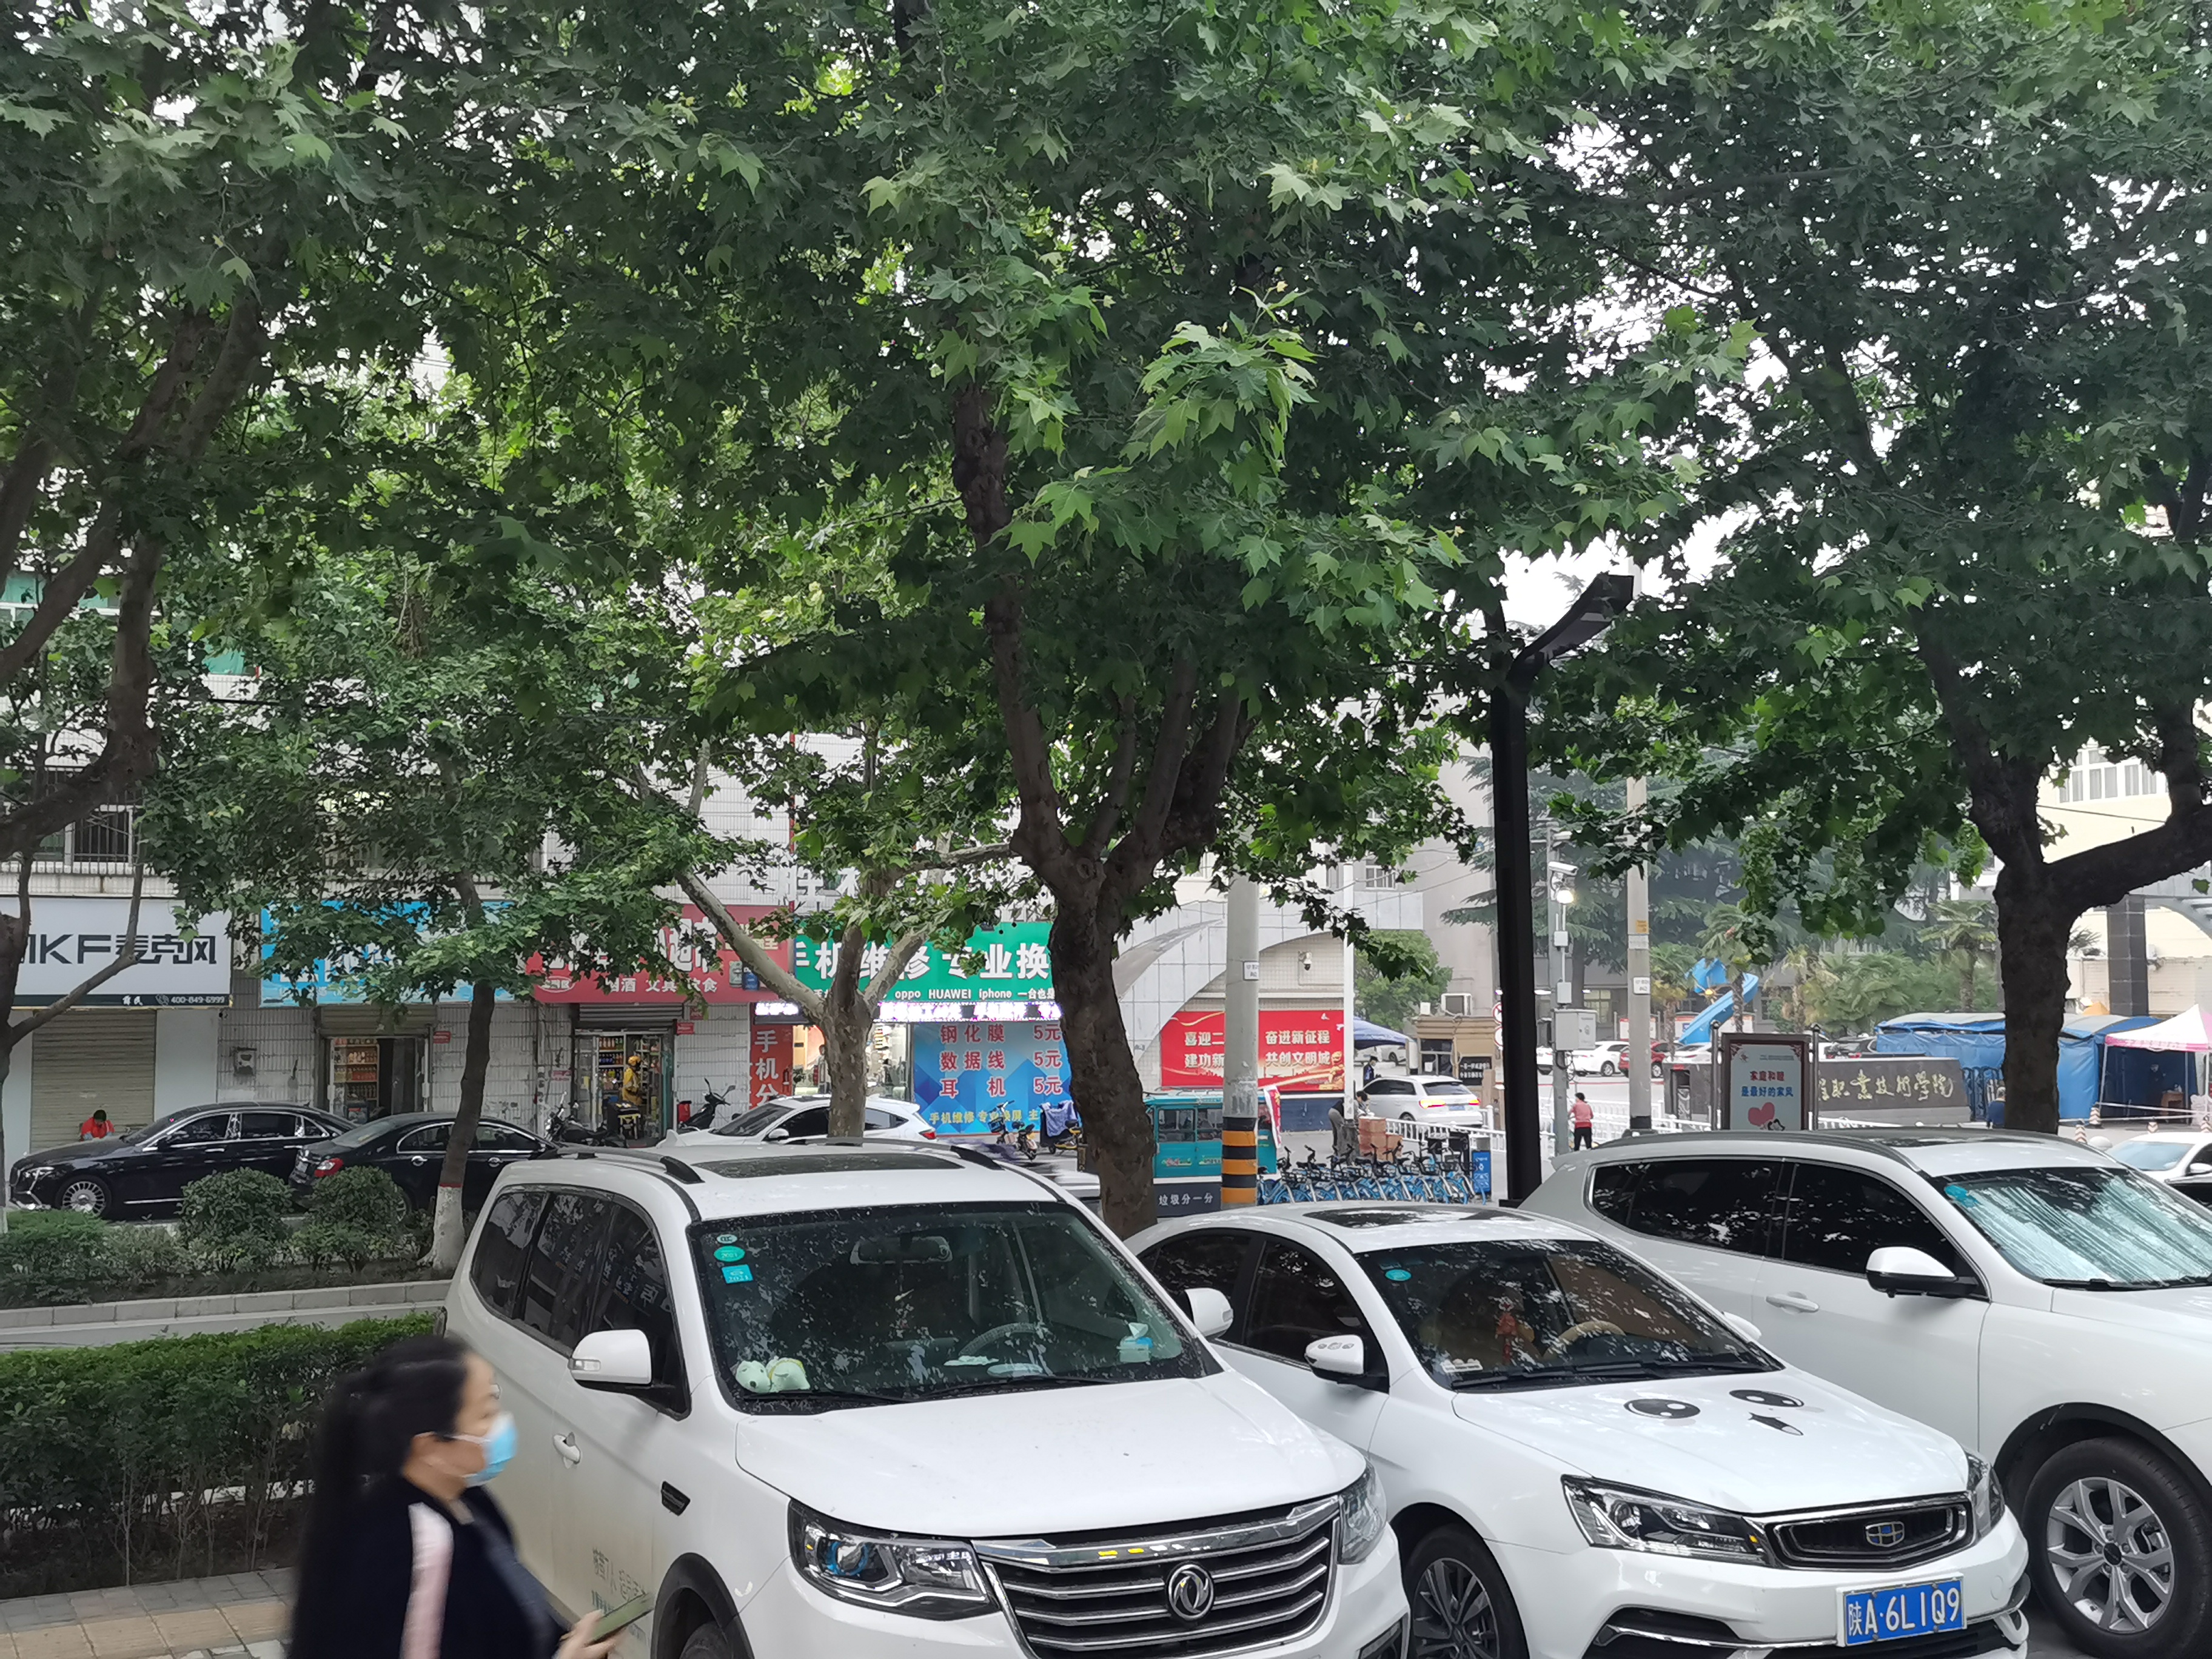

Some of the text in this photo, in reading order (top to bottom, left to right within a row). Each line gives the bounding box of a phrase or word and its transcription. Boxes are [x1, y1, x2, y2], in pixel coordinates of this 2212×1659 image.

[894, 990, 921, 999] oppo
[928, 988, 971, 999] HUAWEI
[940, 1024, 1061, 1044] 钢化膜 5元
[1265, 1030, 1331, 1045] 奋进新征程
[940, 1050, 1062, 1071] 数据线 5元
[1265, 1051, 1330, 1067] 共创文明城
[939, 1076, 1062, 1099] 耳机 5元
[929, 1111, 975, 1125] 手机维修
